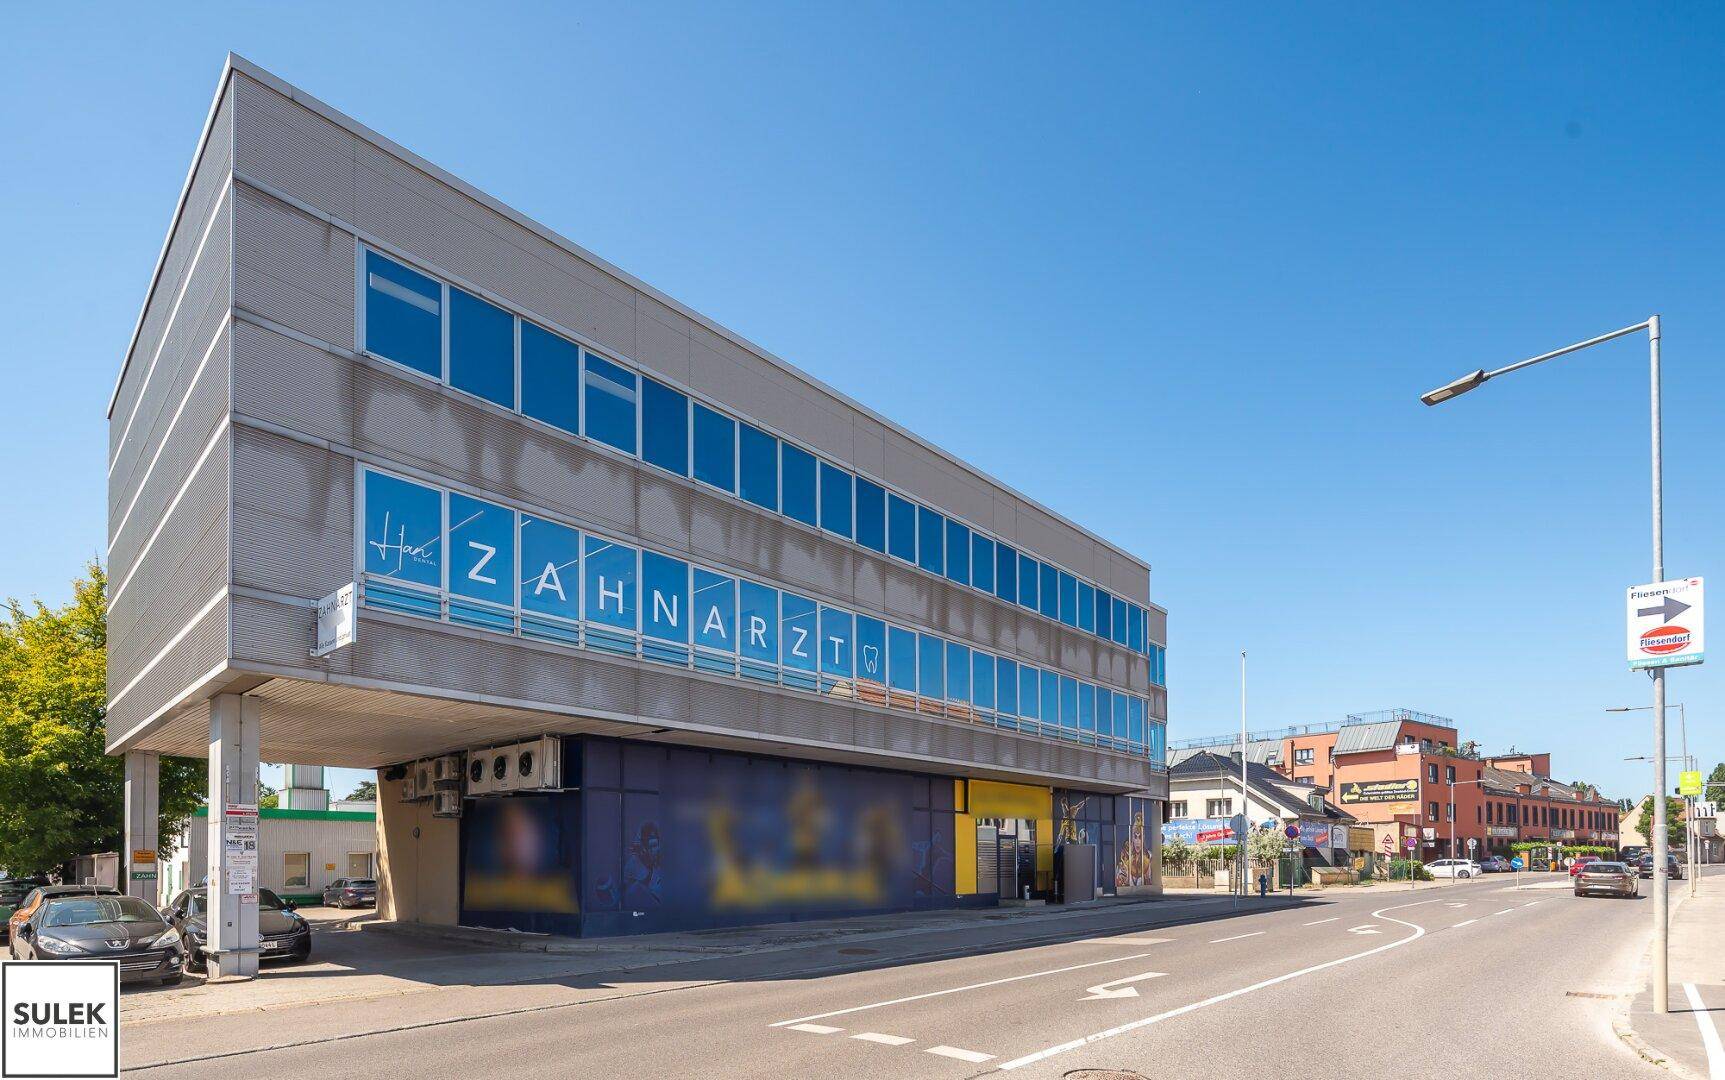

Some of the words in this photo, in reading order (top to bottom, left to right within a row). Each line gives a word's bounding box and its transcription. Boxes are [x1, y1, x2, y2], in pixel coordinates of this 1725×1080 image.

[369, 511, 433, 571] Han
[413, 556, 437, 567] DENTAL
[318, 591, 353, 619] ZAHNARZT
[467, 541, 844, 665] ZAHNARZT
[1640, 633, 1691, 647] Fliesendorf
[244, 841, 256, 850] 18
